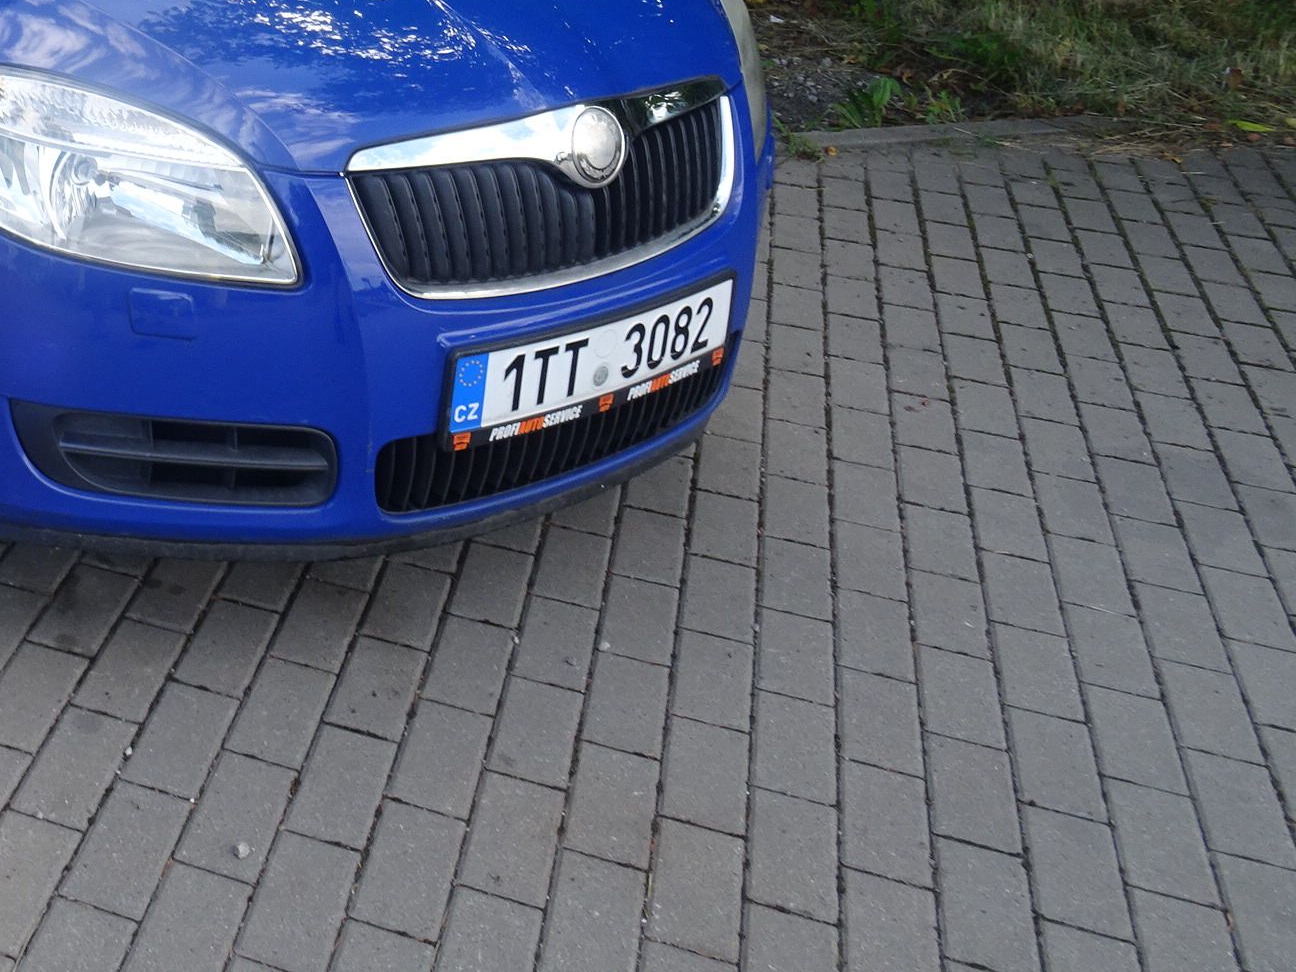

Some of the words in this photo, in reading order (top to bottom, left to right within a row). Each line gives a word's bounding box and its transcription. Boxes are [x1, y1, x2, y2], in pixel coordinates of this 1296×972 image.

[504, 338, 589, 412] 1TT
[621, 297, 714, 378] 3082
[454, 402, 479, 423] CZ
